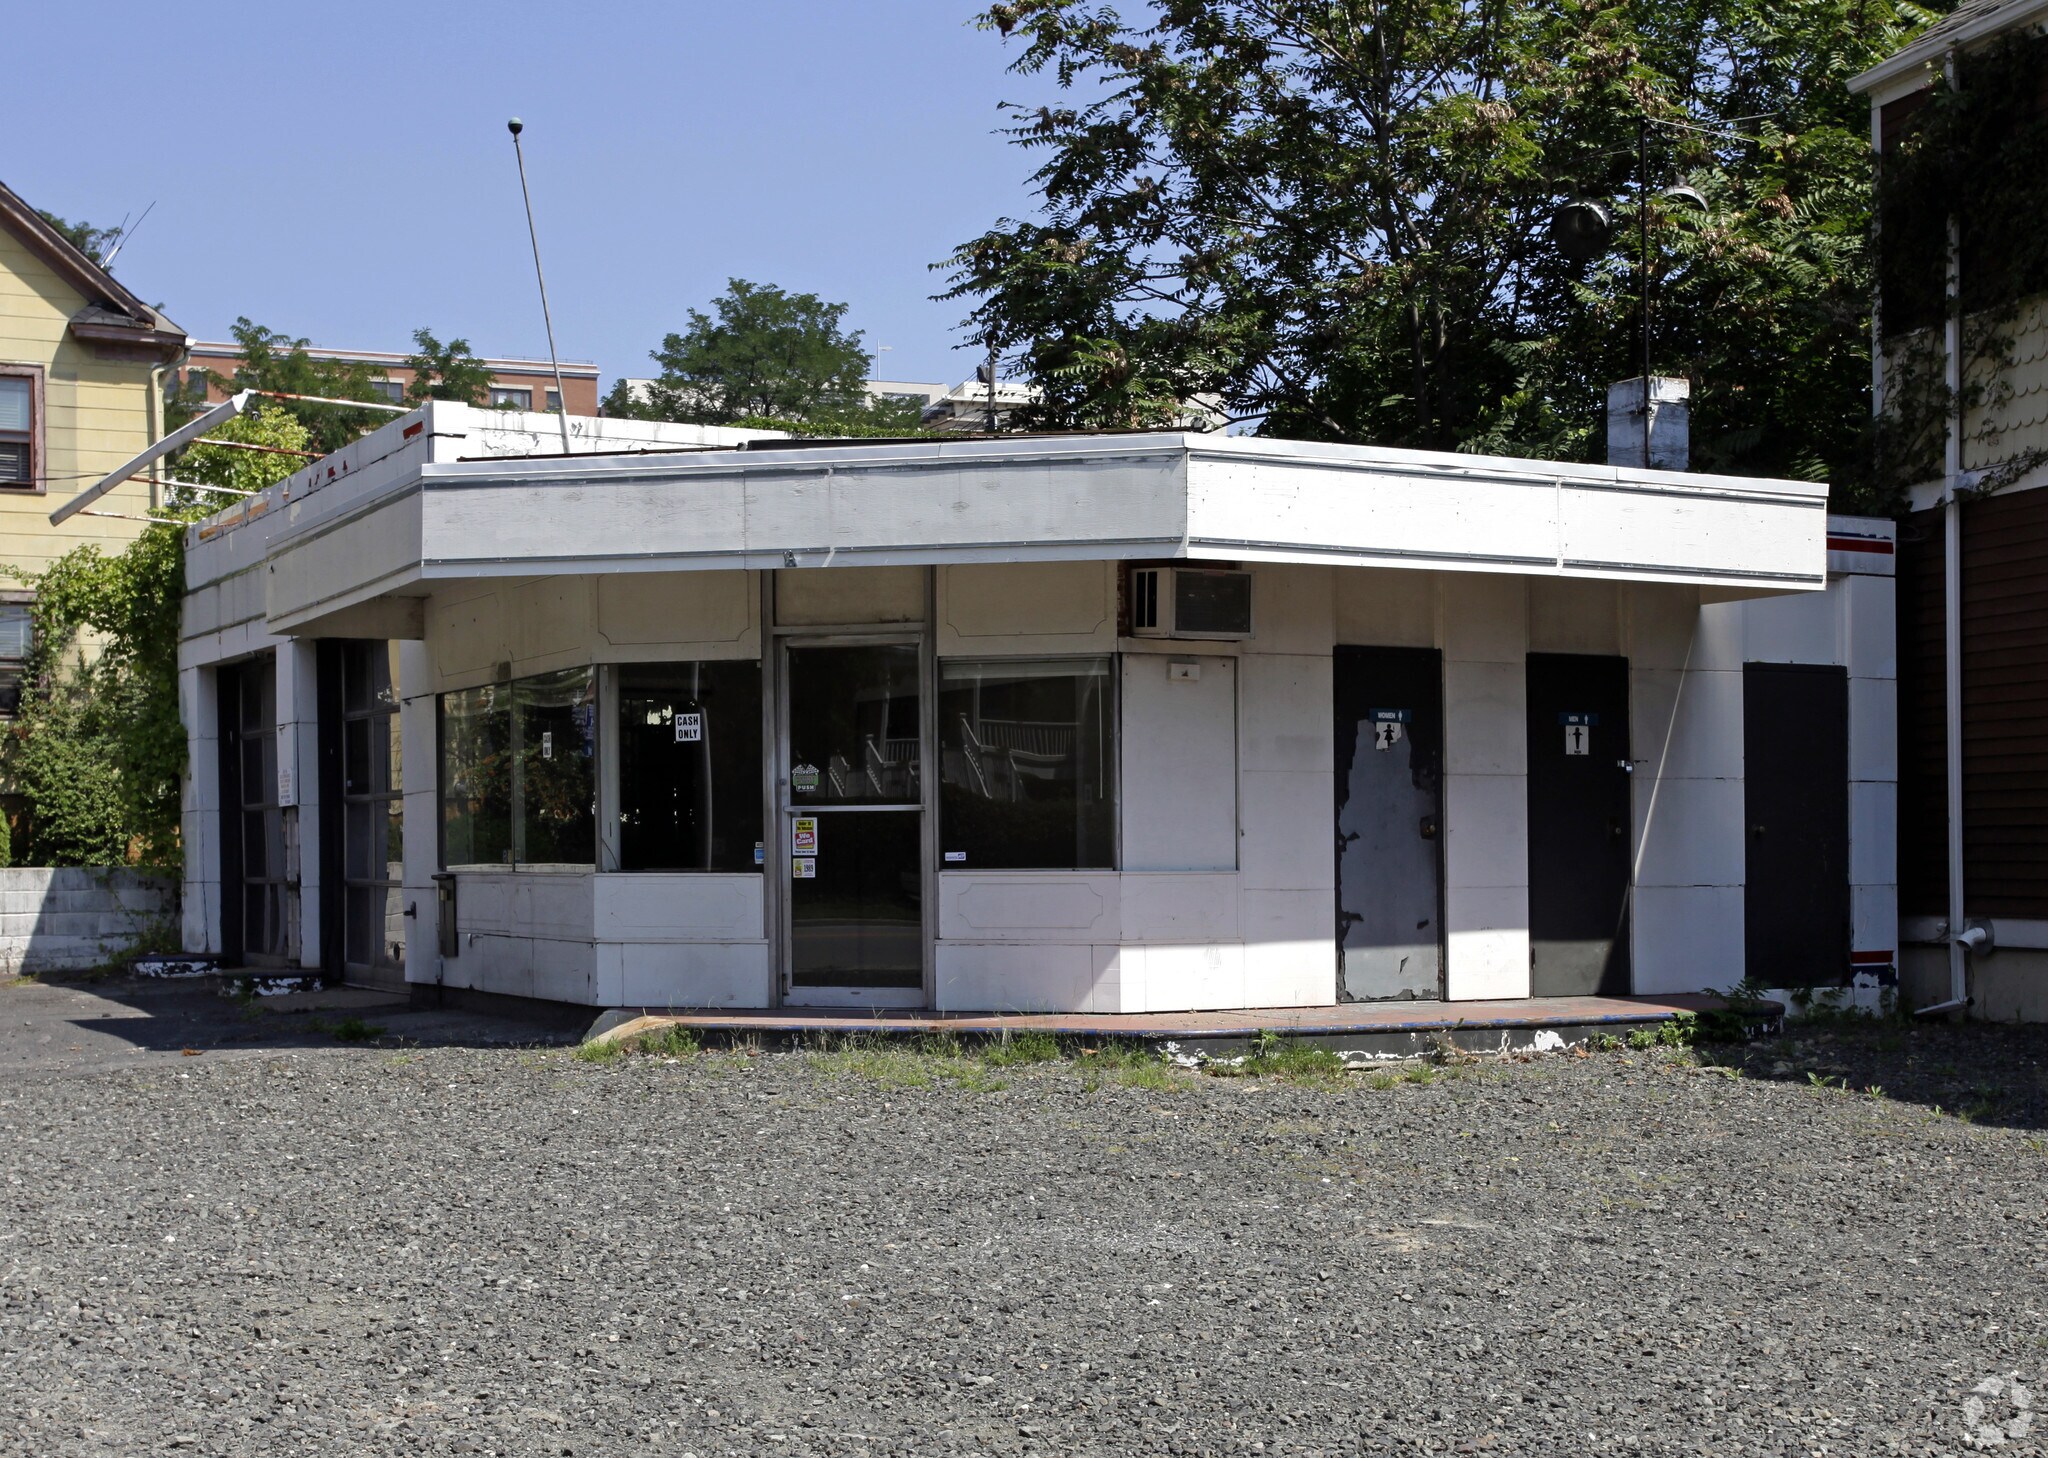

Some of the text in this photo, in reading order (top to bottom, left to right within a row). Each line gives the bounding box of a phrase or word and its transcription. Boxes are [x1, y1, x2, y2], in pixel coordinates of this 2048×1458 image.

[1377, 711, 1396, 719] WOMEN
[677, 716, 698, 726] CASH
[678, 729, 698, 738] ONLY
[796, 837, 813, 845] Card
